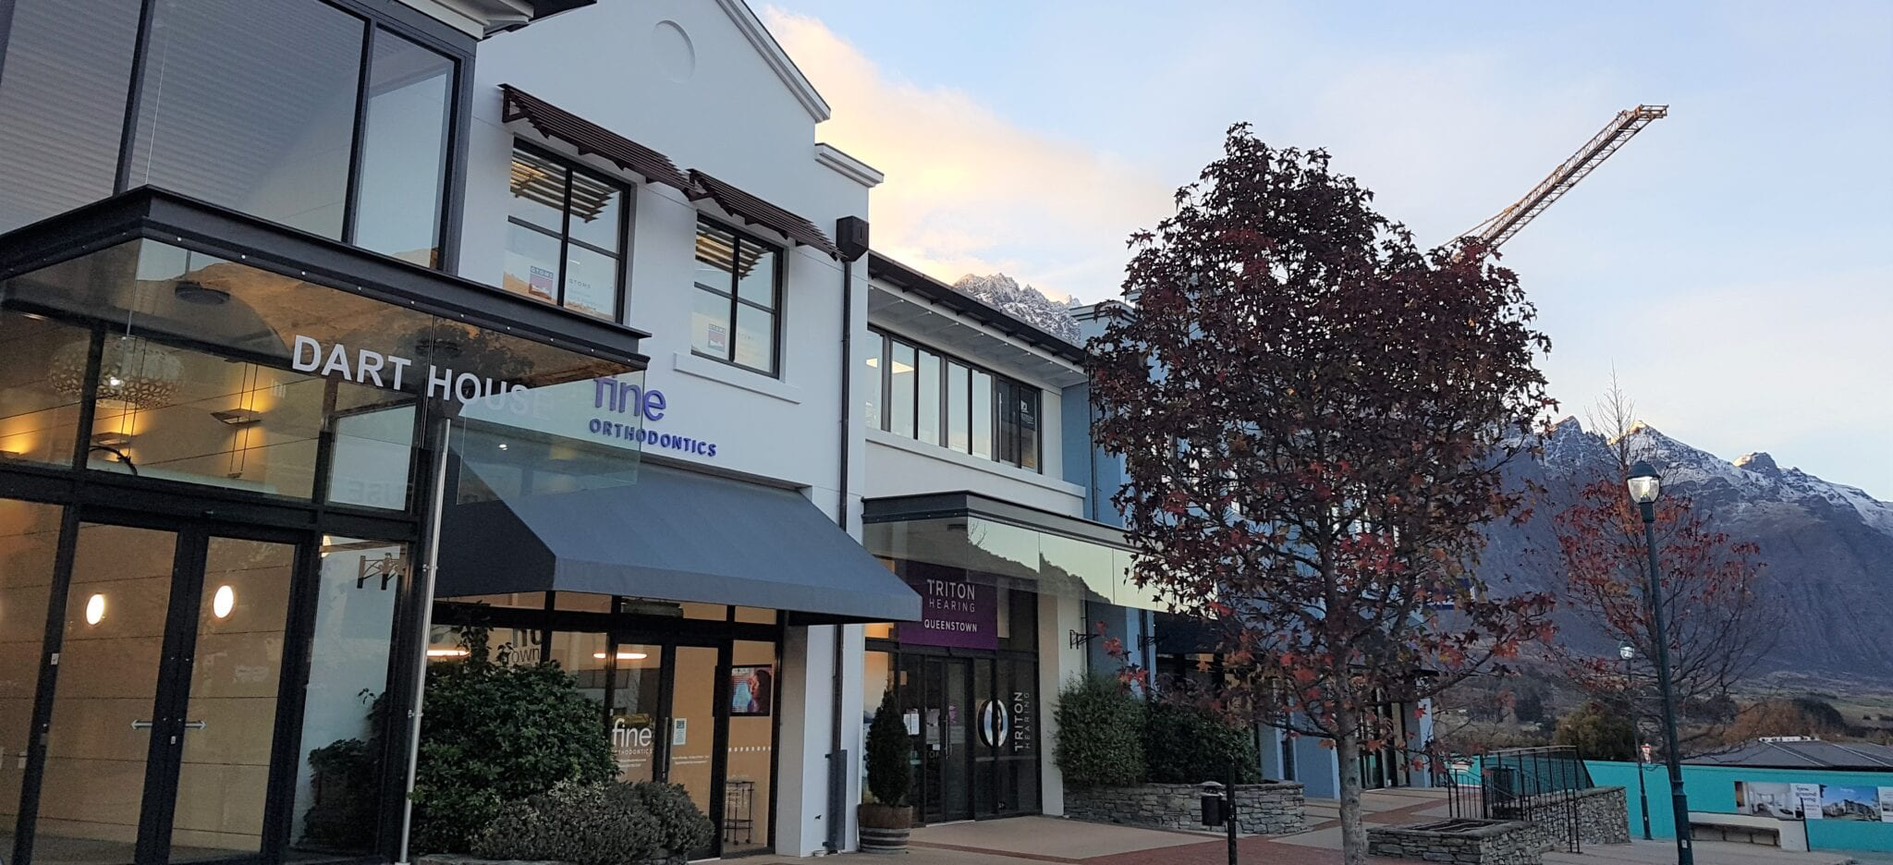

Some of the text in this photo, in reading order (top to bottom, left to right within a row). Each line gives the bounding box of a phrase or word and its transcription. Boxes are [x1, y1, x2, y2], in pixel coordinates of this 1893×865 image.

[292, 335, 412, 391] DART
[593, 376, 667, 422] fine
[589, 418, 717, 457] ORTHODONTICS
[927, 579, 975, 600] TRITON
[929, 598, 976, 613] HEARING
[924, 619, 978, 632] QUEENSTOWN
[612, 718, 652, 747] fine
[1014, 692, 1024, 752] TRITON
[1023, 692, 1031, 749] HEARING
